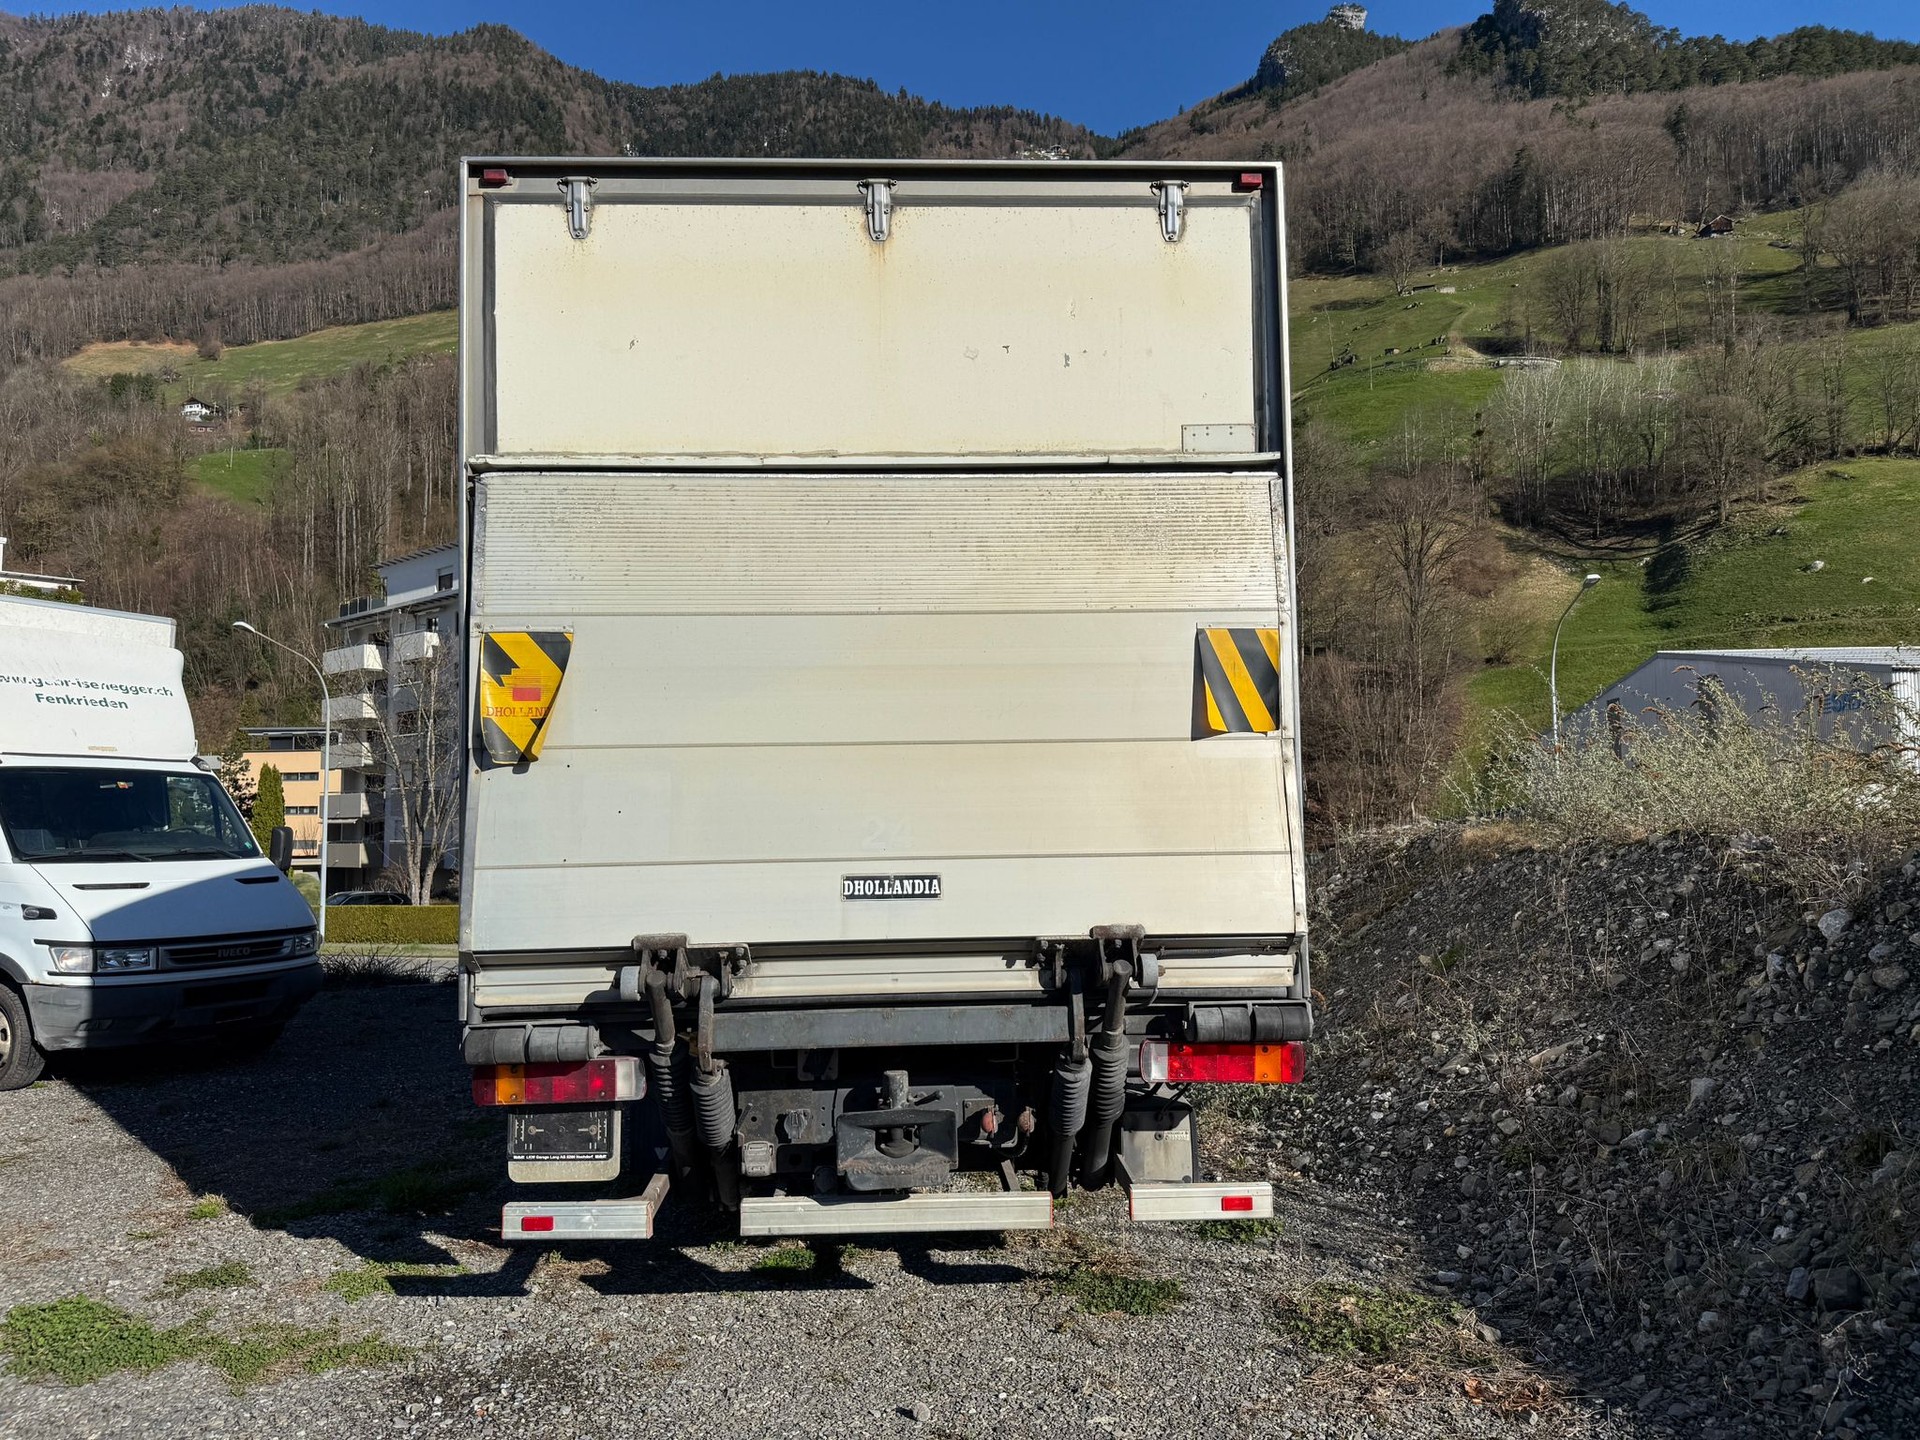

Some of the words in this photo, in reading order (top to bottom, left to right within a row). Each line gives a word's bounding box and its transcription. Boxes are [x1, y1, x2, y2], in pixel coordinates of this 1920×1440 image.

[35, 693, 129, 709] Fenkrieden
[843, 879, 941, 895] DHOLLANDIA
[217, 946, 251, 958] IVECO
